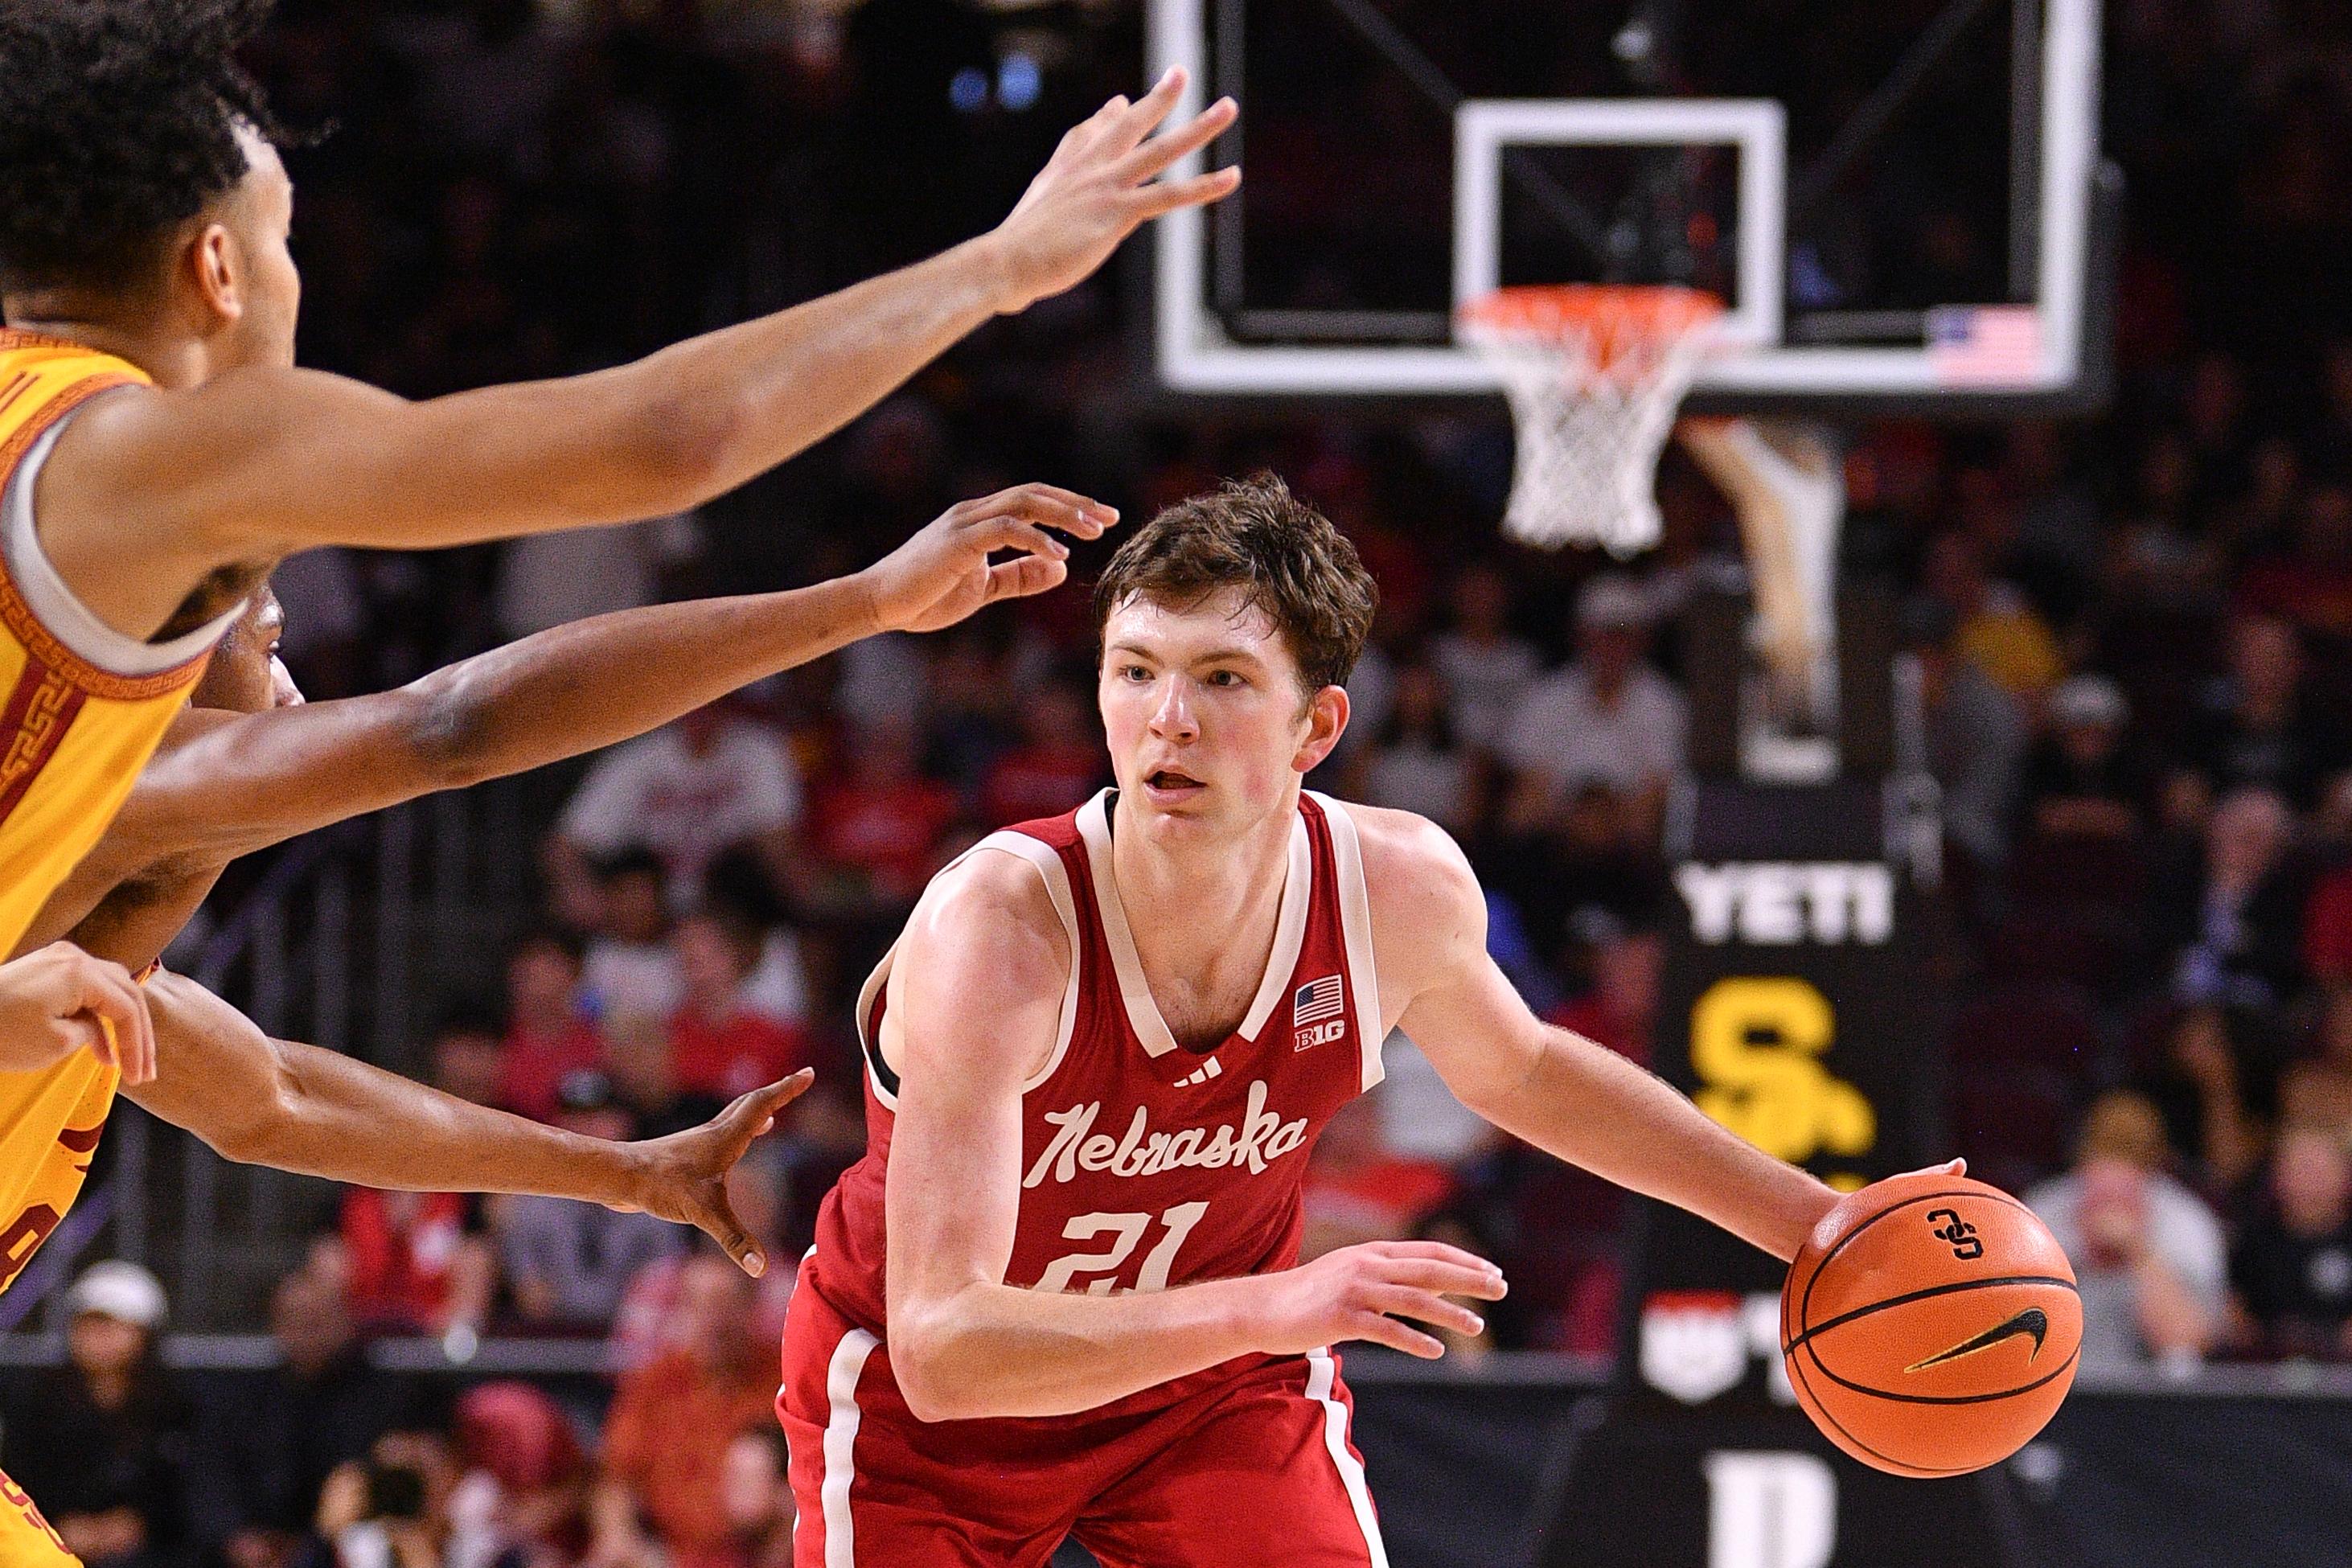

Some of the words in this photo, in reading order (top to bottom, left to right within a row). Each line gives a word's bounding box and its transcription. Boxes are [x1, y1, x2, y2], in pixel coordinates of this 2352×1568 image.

[1673, 860, 1893, 945] YETI
[1022, 1079, 1308, 1188] Nebraska
[1032, 1201, 1210, 1297] 21
